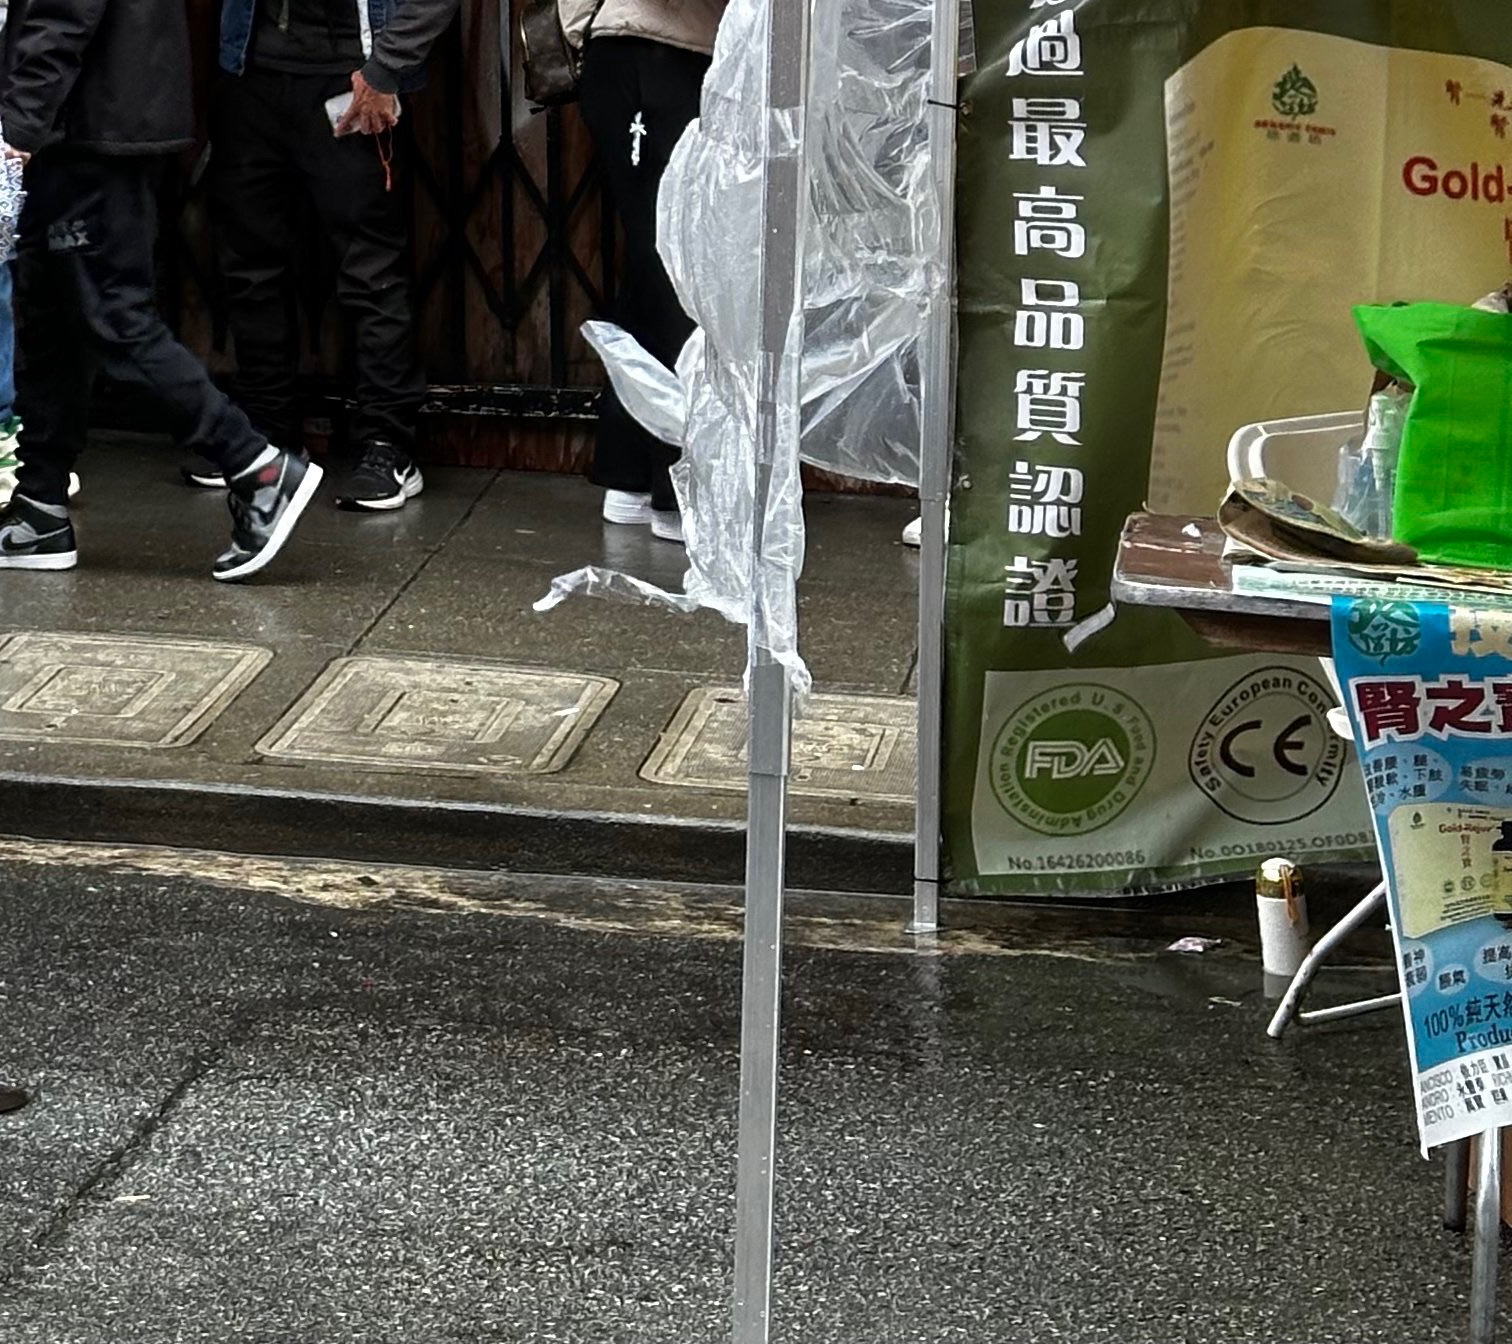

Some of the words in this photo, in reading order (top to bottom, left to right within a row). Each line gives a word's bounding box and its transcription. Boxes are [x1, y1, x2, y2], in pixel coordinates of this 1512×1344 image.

[1000, 689, 1083, 758] Registered
[1210, 676, 1294, 728] European
[1024, 736, 1126, 780] FDA
[1219, 713, 1313, 778] CE
[1455, 1023, 1512, 1054] Produ
